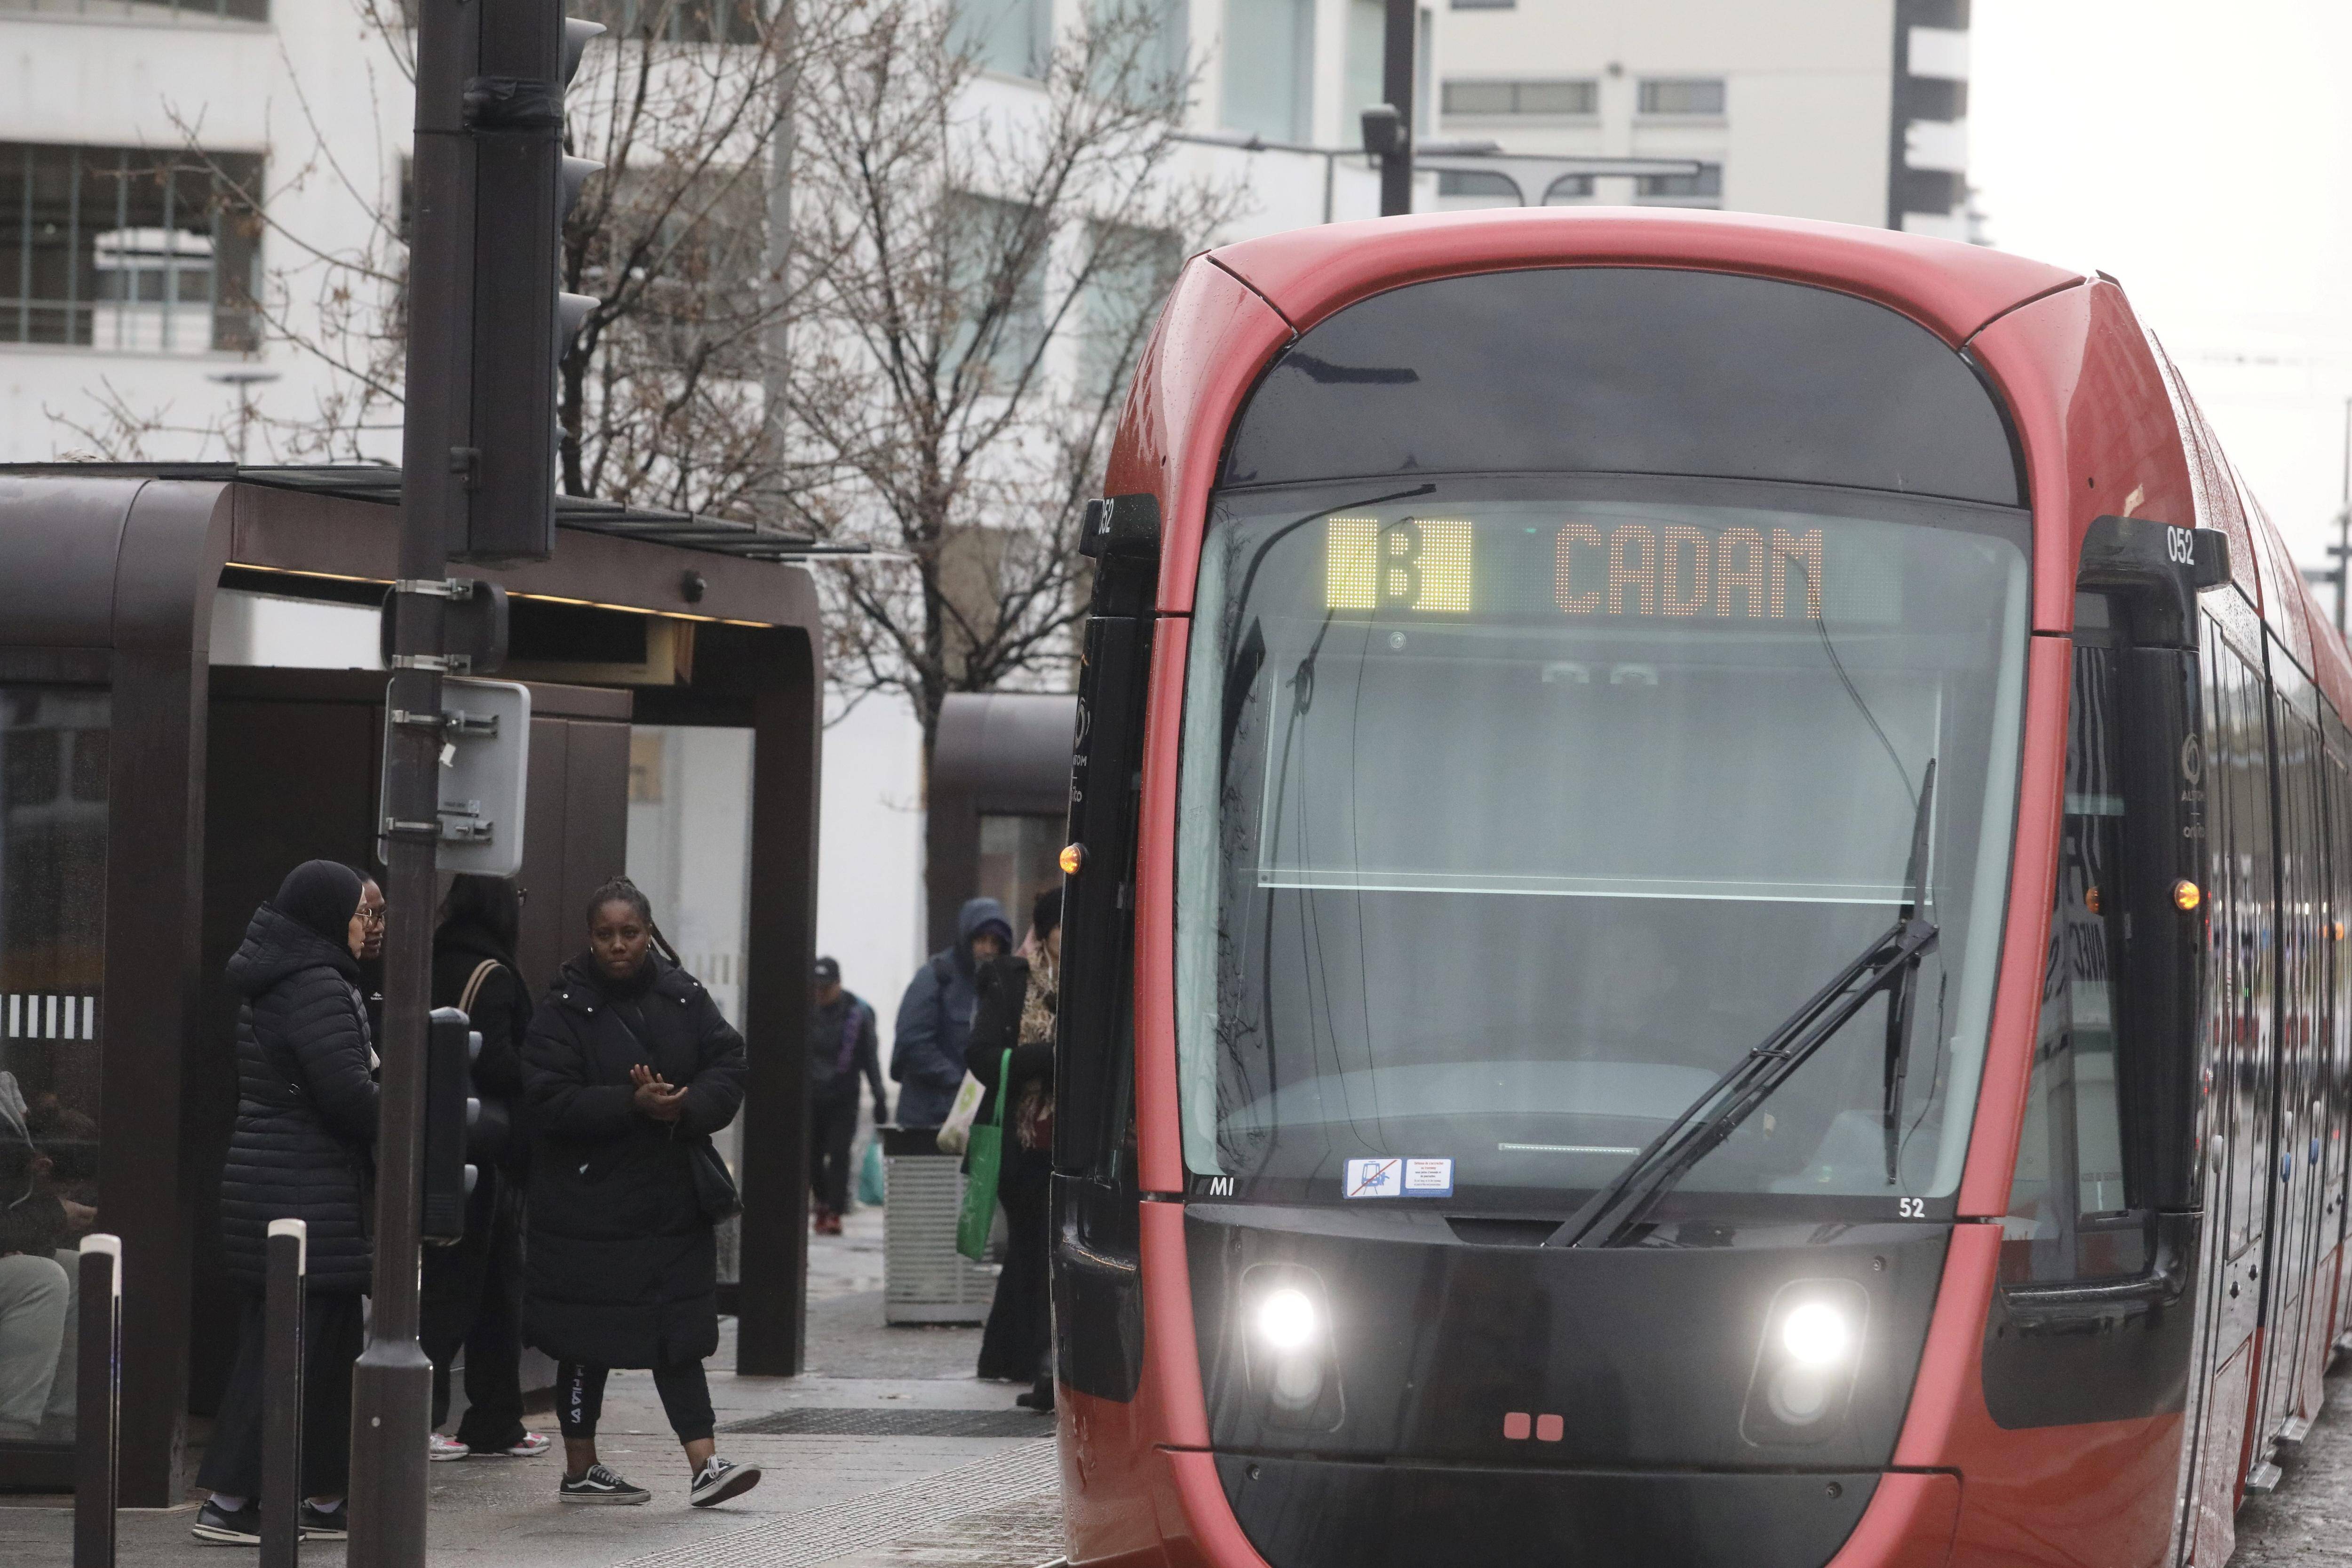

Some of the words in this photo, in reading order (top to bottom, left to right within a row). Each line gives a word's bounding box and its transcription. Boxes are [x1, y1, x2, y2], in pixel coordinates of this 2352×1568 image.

[2167, 525, 2195, 565] 052
[1376, 520, 1422, 608] B
[1554, 523, 1823, 618] CADAM
[1899, 1198, 1925, 1218] 52
